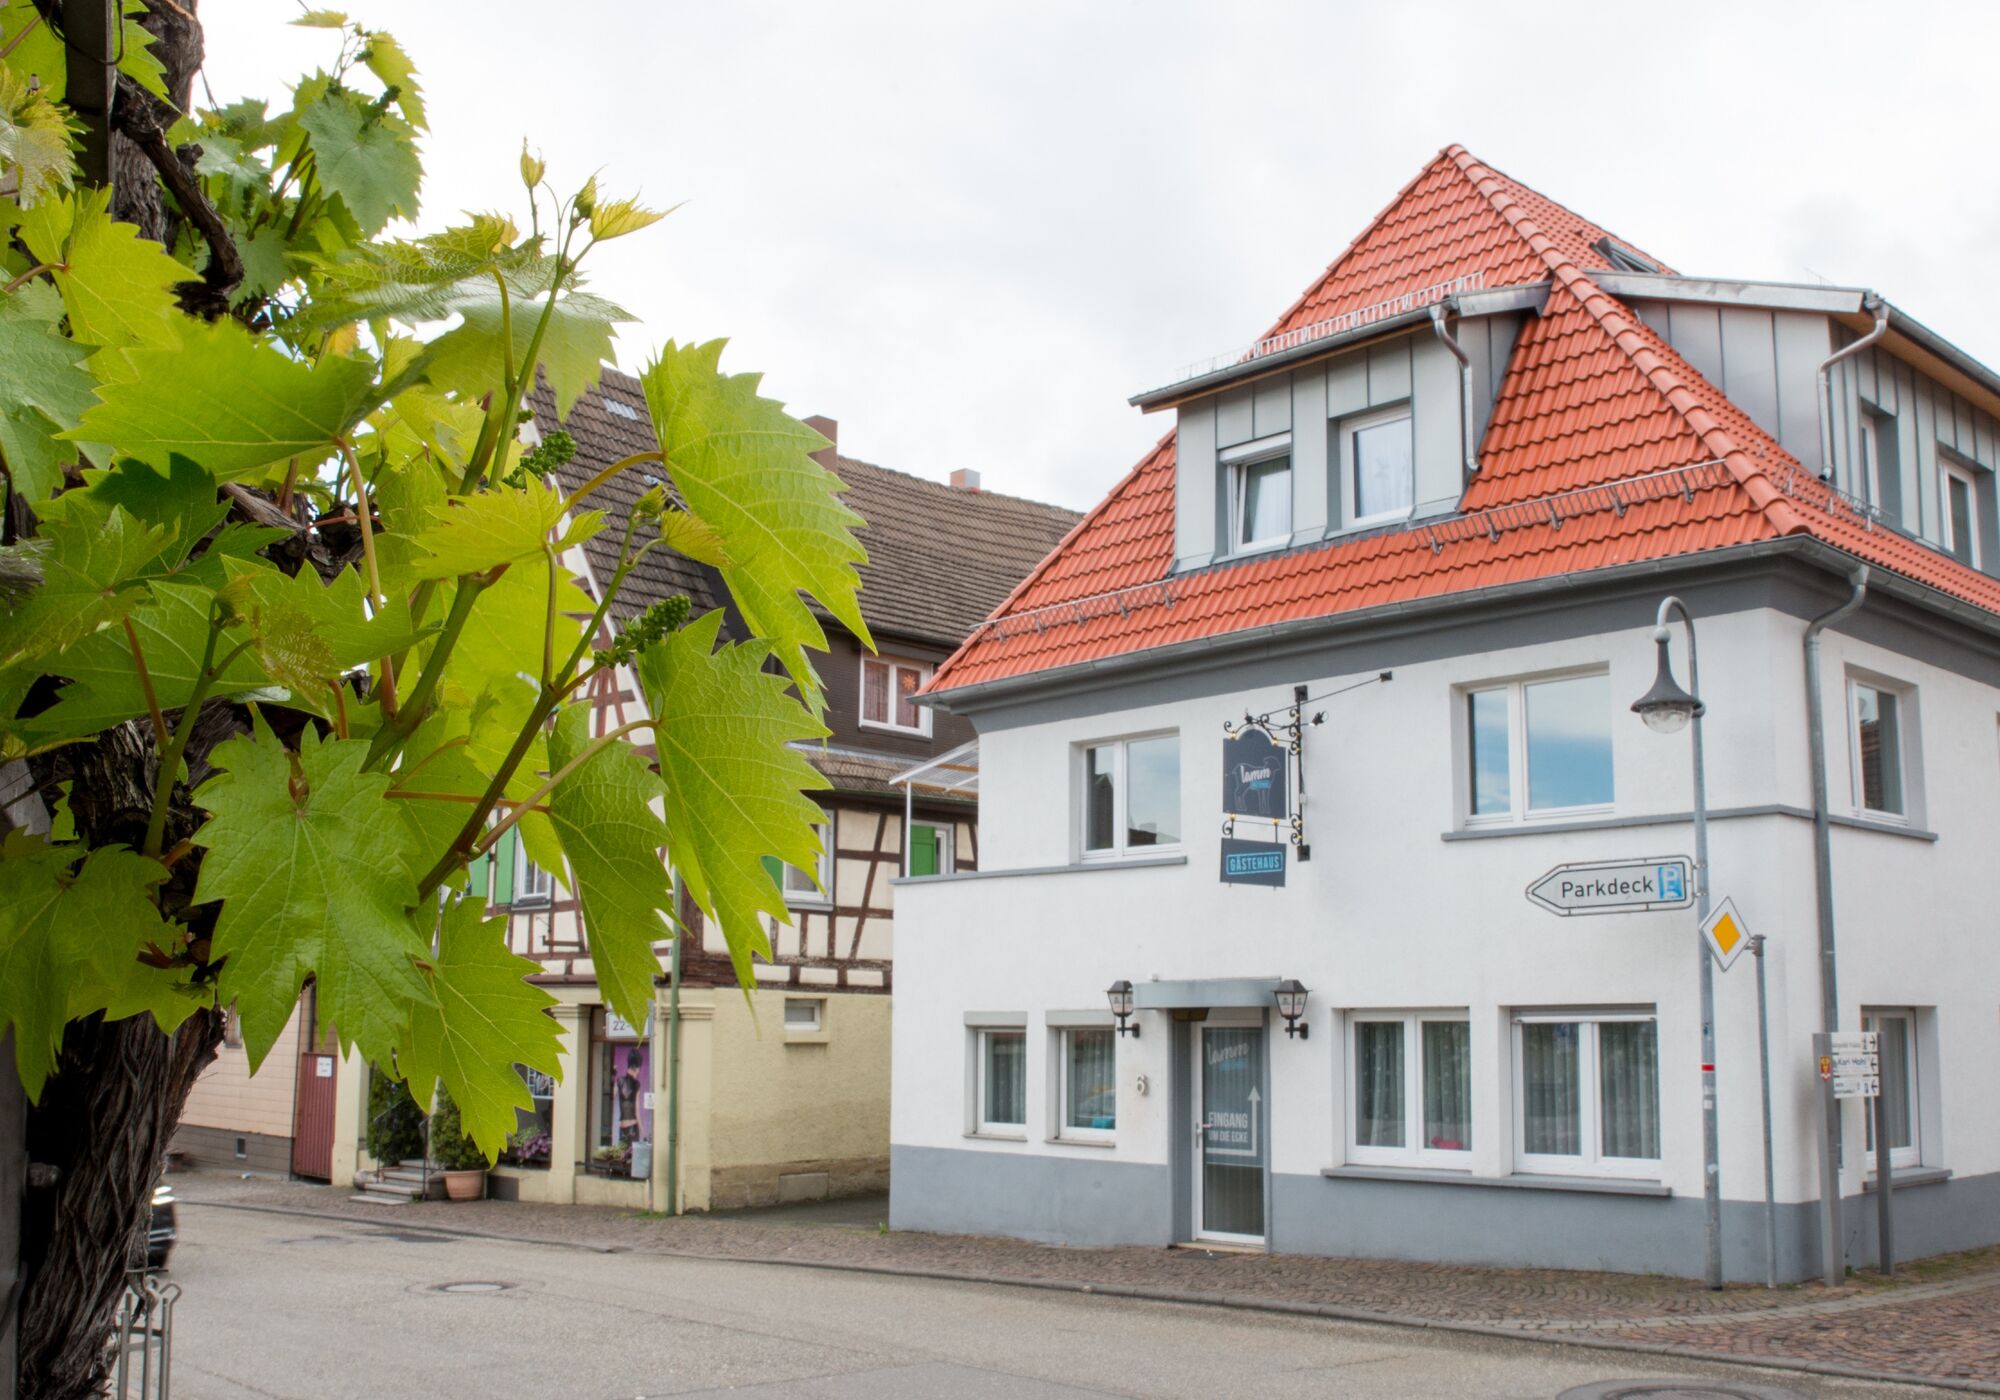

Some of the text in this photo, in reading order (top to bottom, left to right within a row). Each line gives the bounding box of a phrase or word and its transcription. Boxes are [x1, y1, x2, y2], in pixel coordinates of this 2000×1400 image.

[1240, 765, 1271, 784] lamm
[1229, 855, 1280, 872] GÄSTEHAUS
[1561, 876, 1654, 899] Parkdeck
[612, 1020, 631, 1031] 22-
[1136, 1073, 1147, 1097] 6
[1208, 1111, 1248, 1129] EINGANG
[1208, 1130, 1248, 1143] UM DIE ECKE
